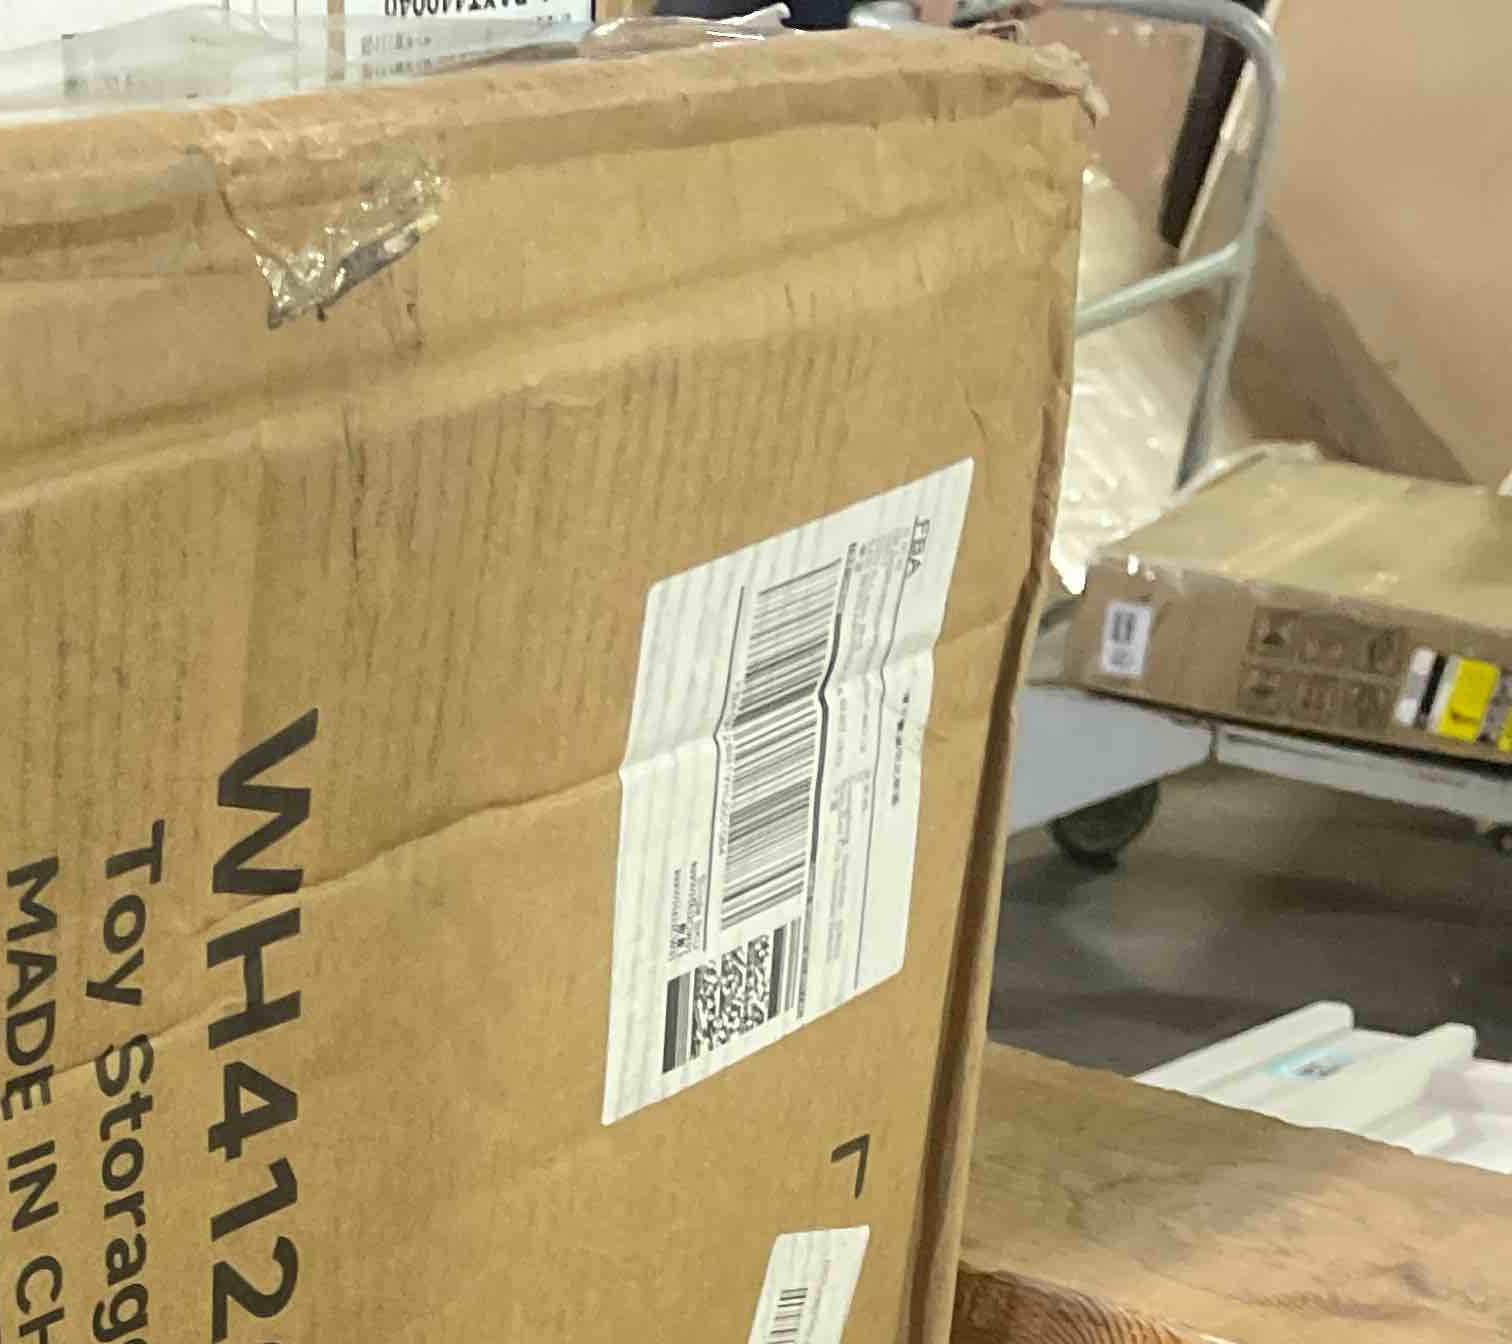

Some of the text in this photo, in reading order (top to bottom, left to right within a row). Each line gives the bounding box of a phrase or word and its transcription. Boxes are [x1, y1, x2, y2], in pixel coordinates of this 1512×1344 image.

[906, 519, 931, 575] FBA
[85, 819, 165, 1006] Toy
[0, 856, 59, 1121] MADE
[7, 1139, 60, 1232] IN
